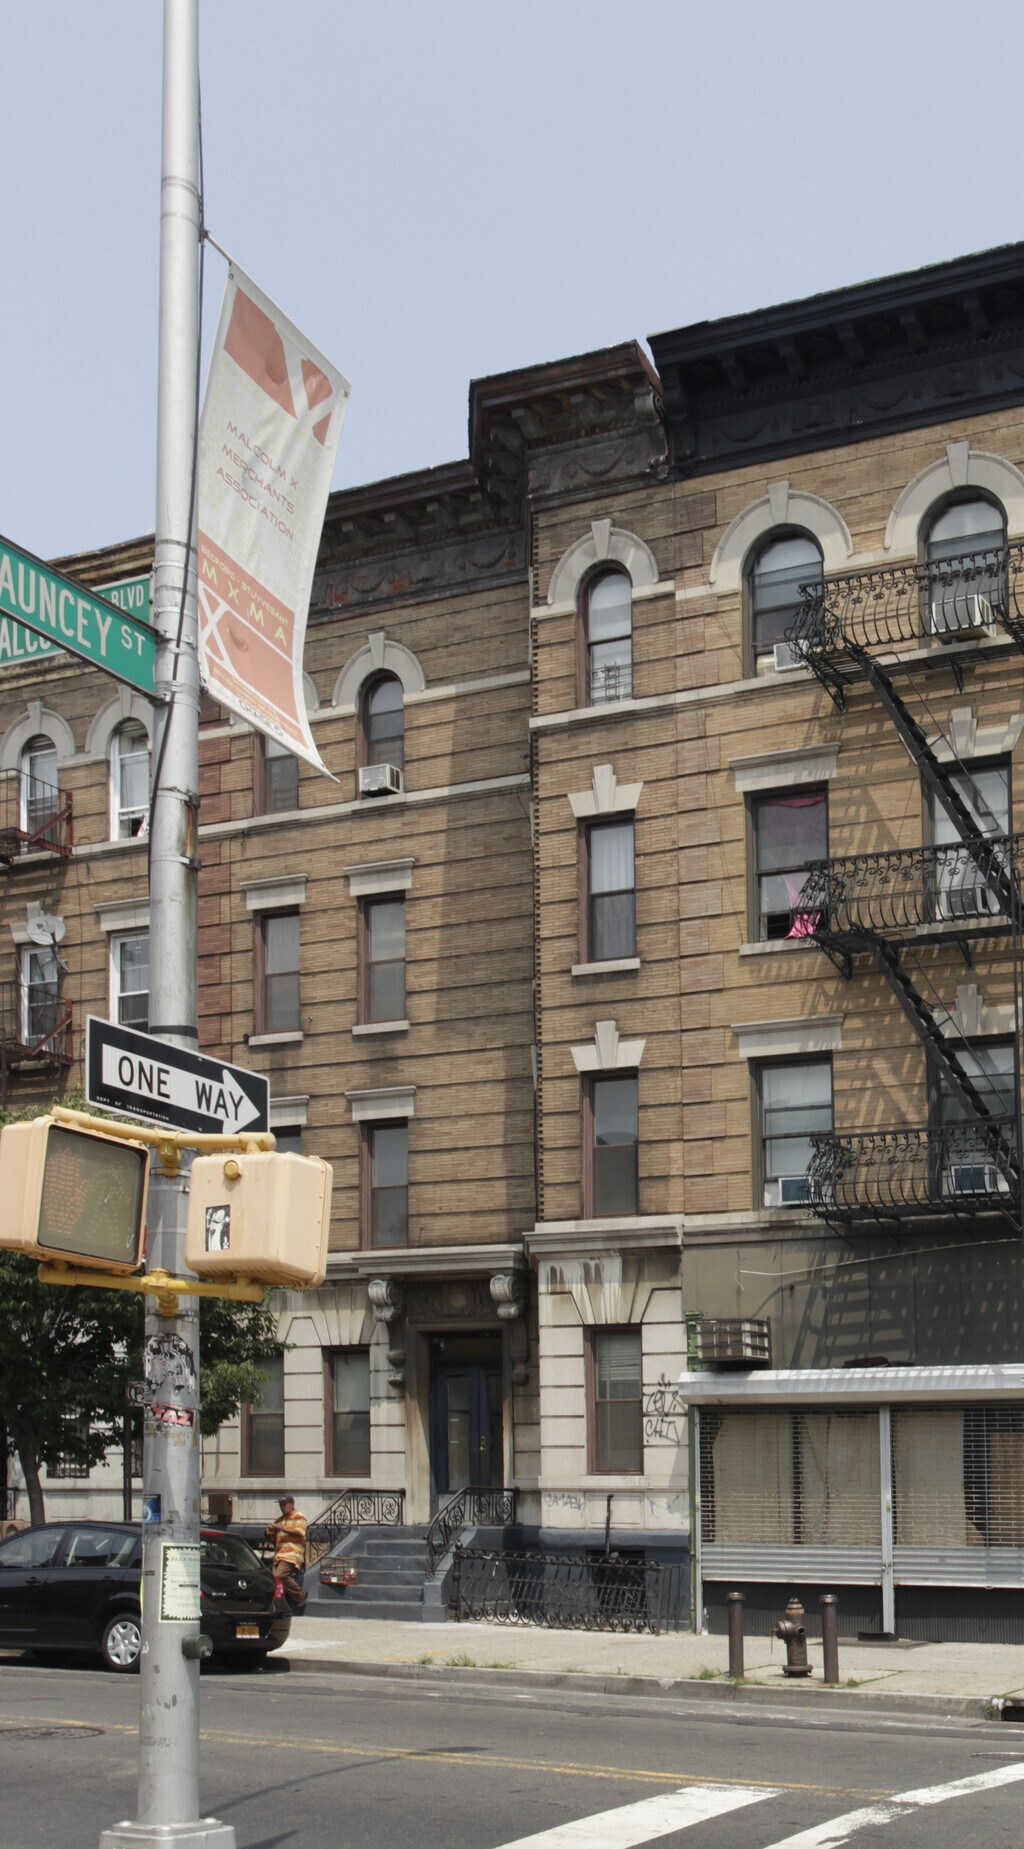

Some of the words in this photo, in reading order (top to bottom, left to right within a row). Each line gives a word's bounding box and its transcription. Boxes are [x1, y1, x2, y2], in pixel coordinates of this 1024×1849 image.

[222, 443, 295, 515] MERCHANTS
[227, 420, 287, 481] MALCOLM
[290, 475, 299, 491] X
[216, 467, 294, 541] ASSOCIATION
[111, 584, 145, 610] BLVD
[200, 544, 236, 581] BEDFORD
[241, 582, 290, 627] STUYVESANT
[121, 624, 146, 657] ST
[96, 1095, 110, 1104] DEPT
[126, 1104, 170, 1121] TRANSPORTATION
[118, 1055, 171, 1099] ONE
[195, 1080, 245, 1121] WAY
